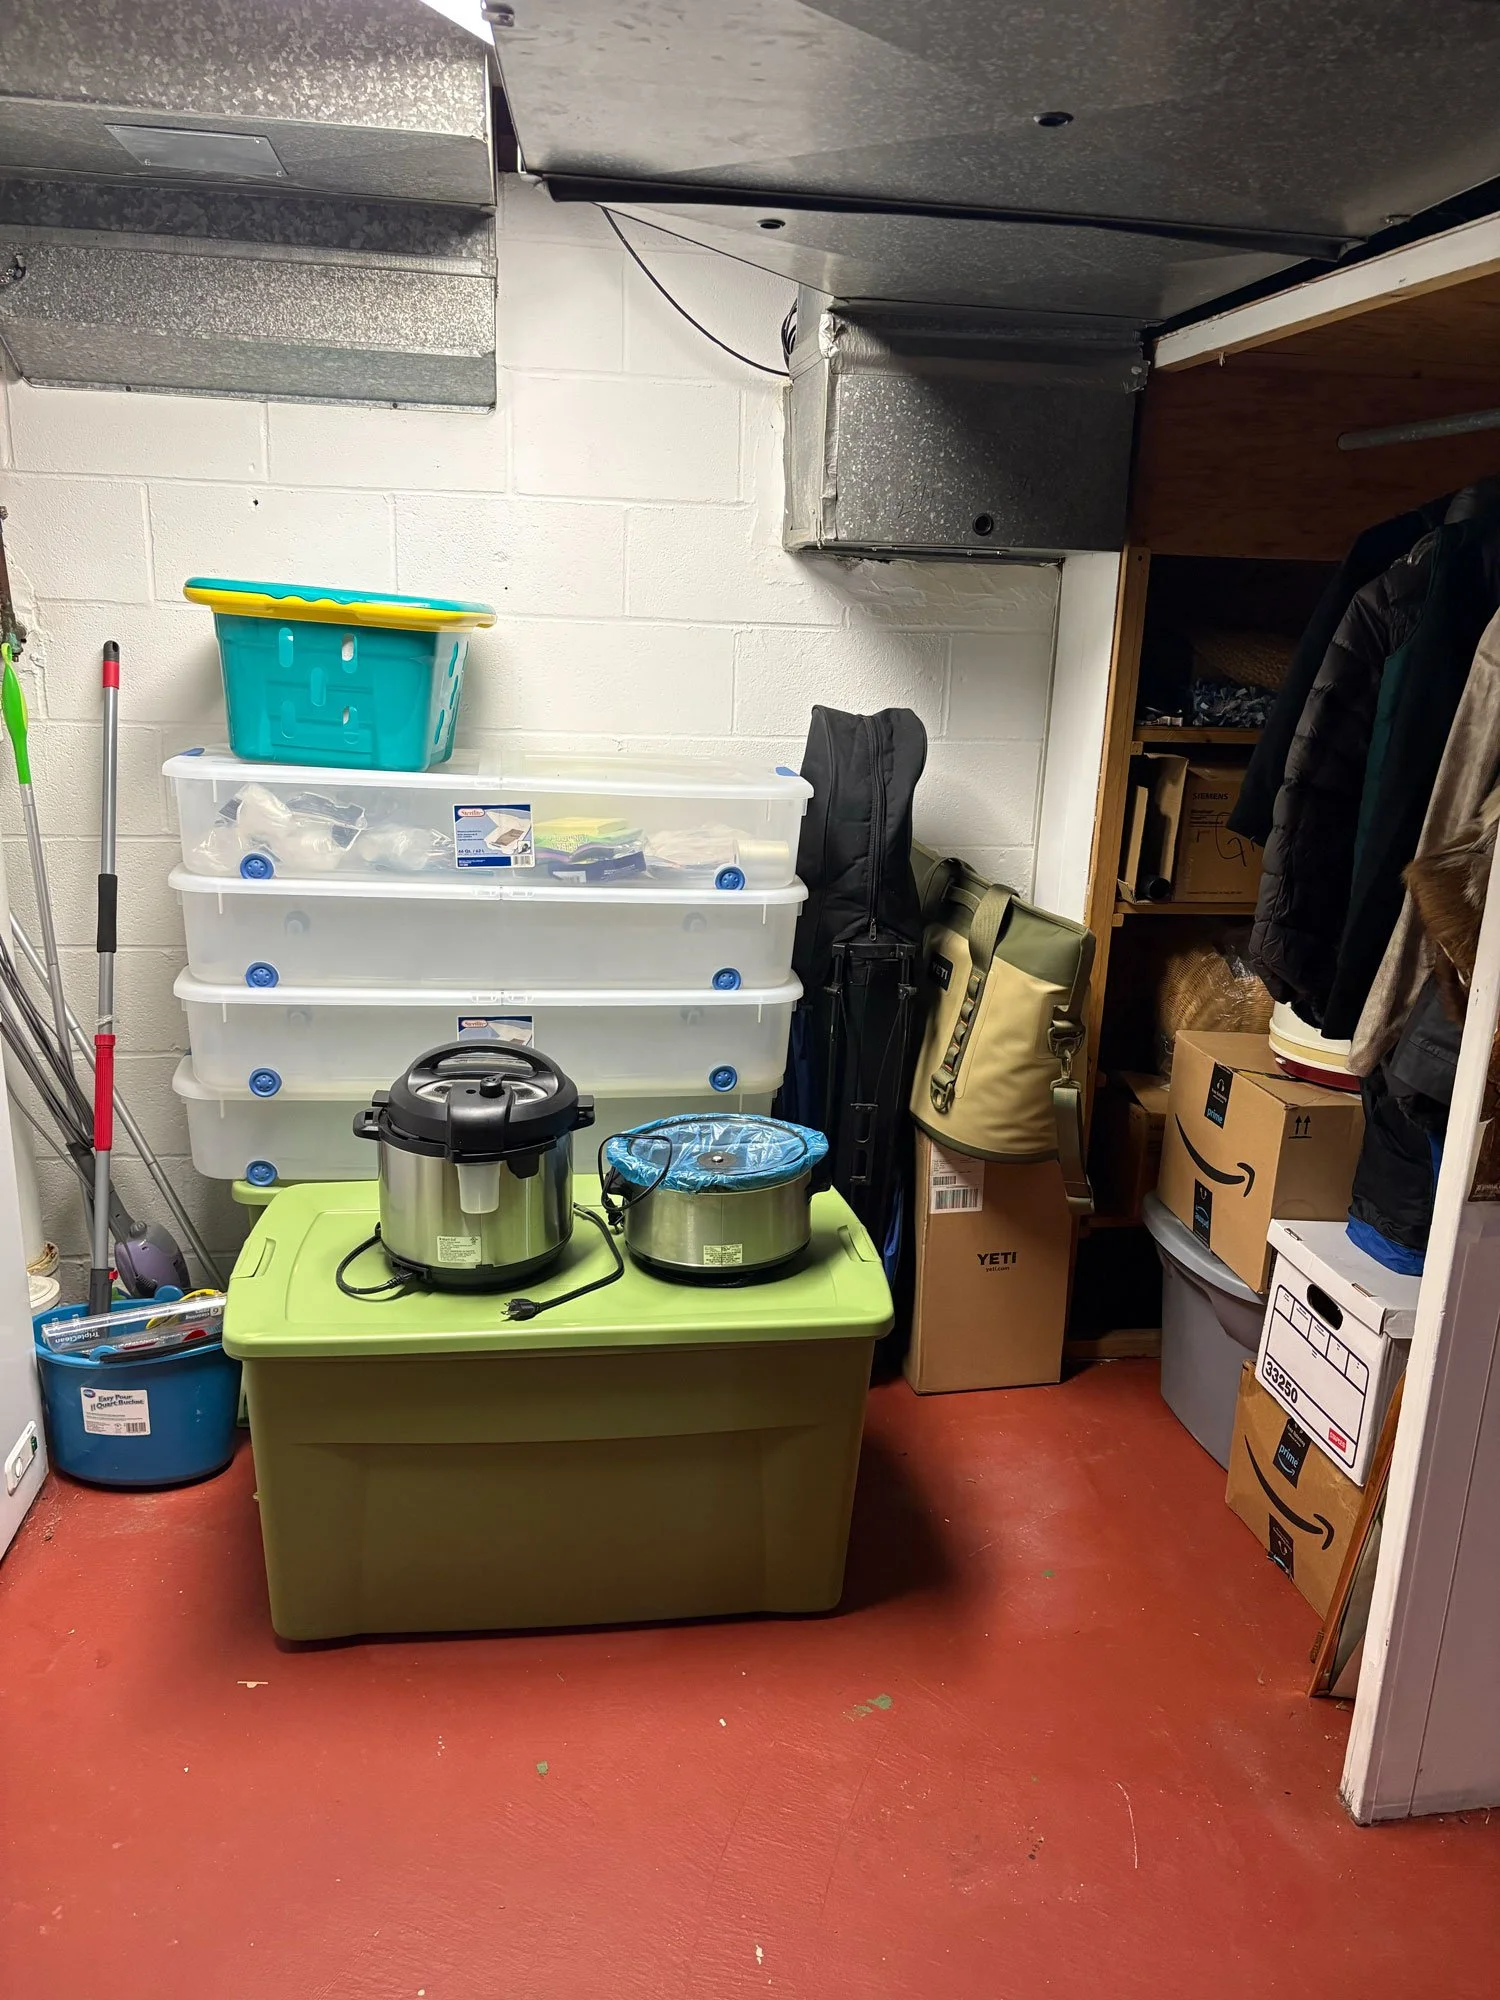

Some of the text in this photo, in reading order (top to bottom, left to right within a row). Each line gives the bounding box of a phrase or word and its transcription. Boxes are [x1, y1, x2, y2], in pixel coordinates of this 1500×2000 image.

[1192, 792, 1229, 801] SIEMENS
[1206, 1107, 1224, 1124] prime
[976, 1251, 1017, 1266] YETI
[55, 1330, 100, 1344] TripleClean
[1265, 1360, 1299, 1404] 33250
[1278, 1444, 1299, 1468] prime
